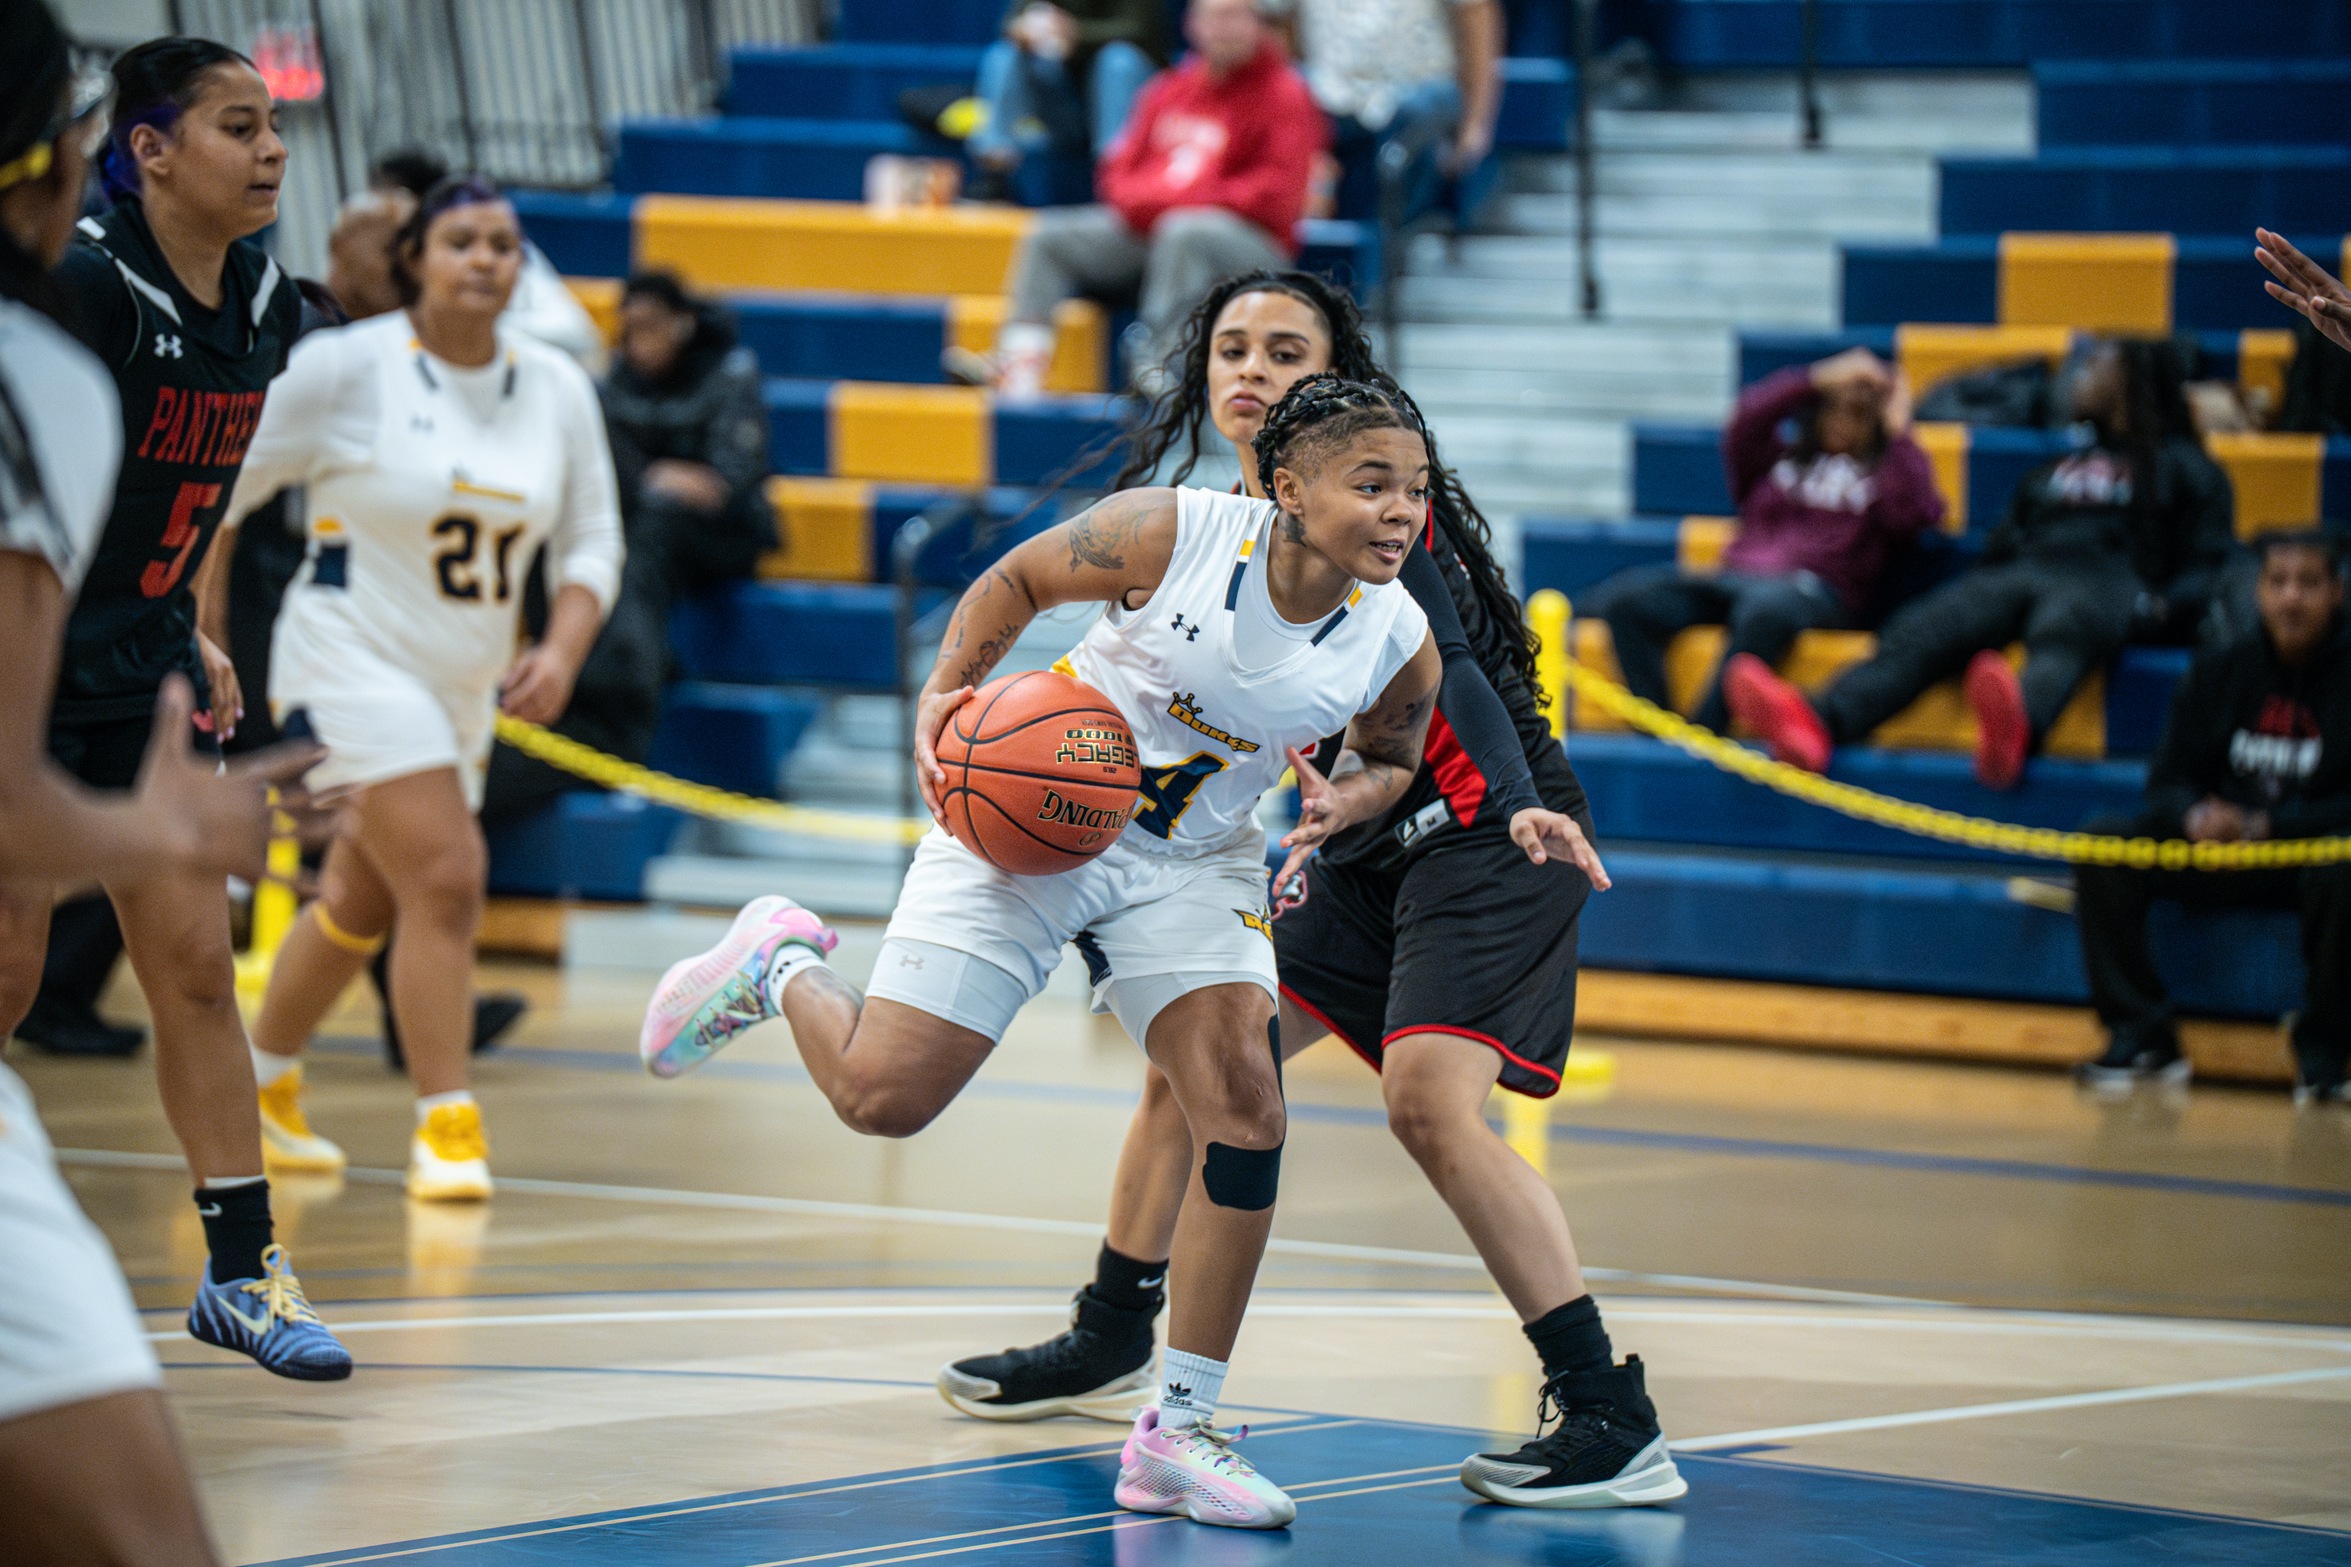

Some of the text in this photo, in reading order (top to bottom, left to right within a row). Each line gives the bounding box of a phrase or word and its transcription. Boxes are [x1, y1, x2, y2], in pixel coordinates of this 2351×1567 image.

[140, 481, 223, 598] 5
[430, 511, 527, 605] 21
[1131, 750, 1230, 841] 4
[1163, 1394, 1193, 1406] adidas
